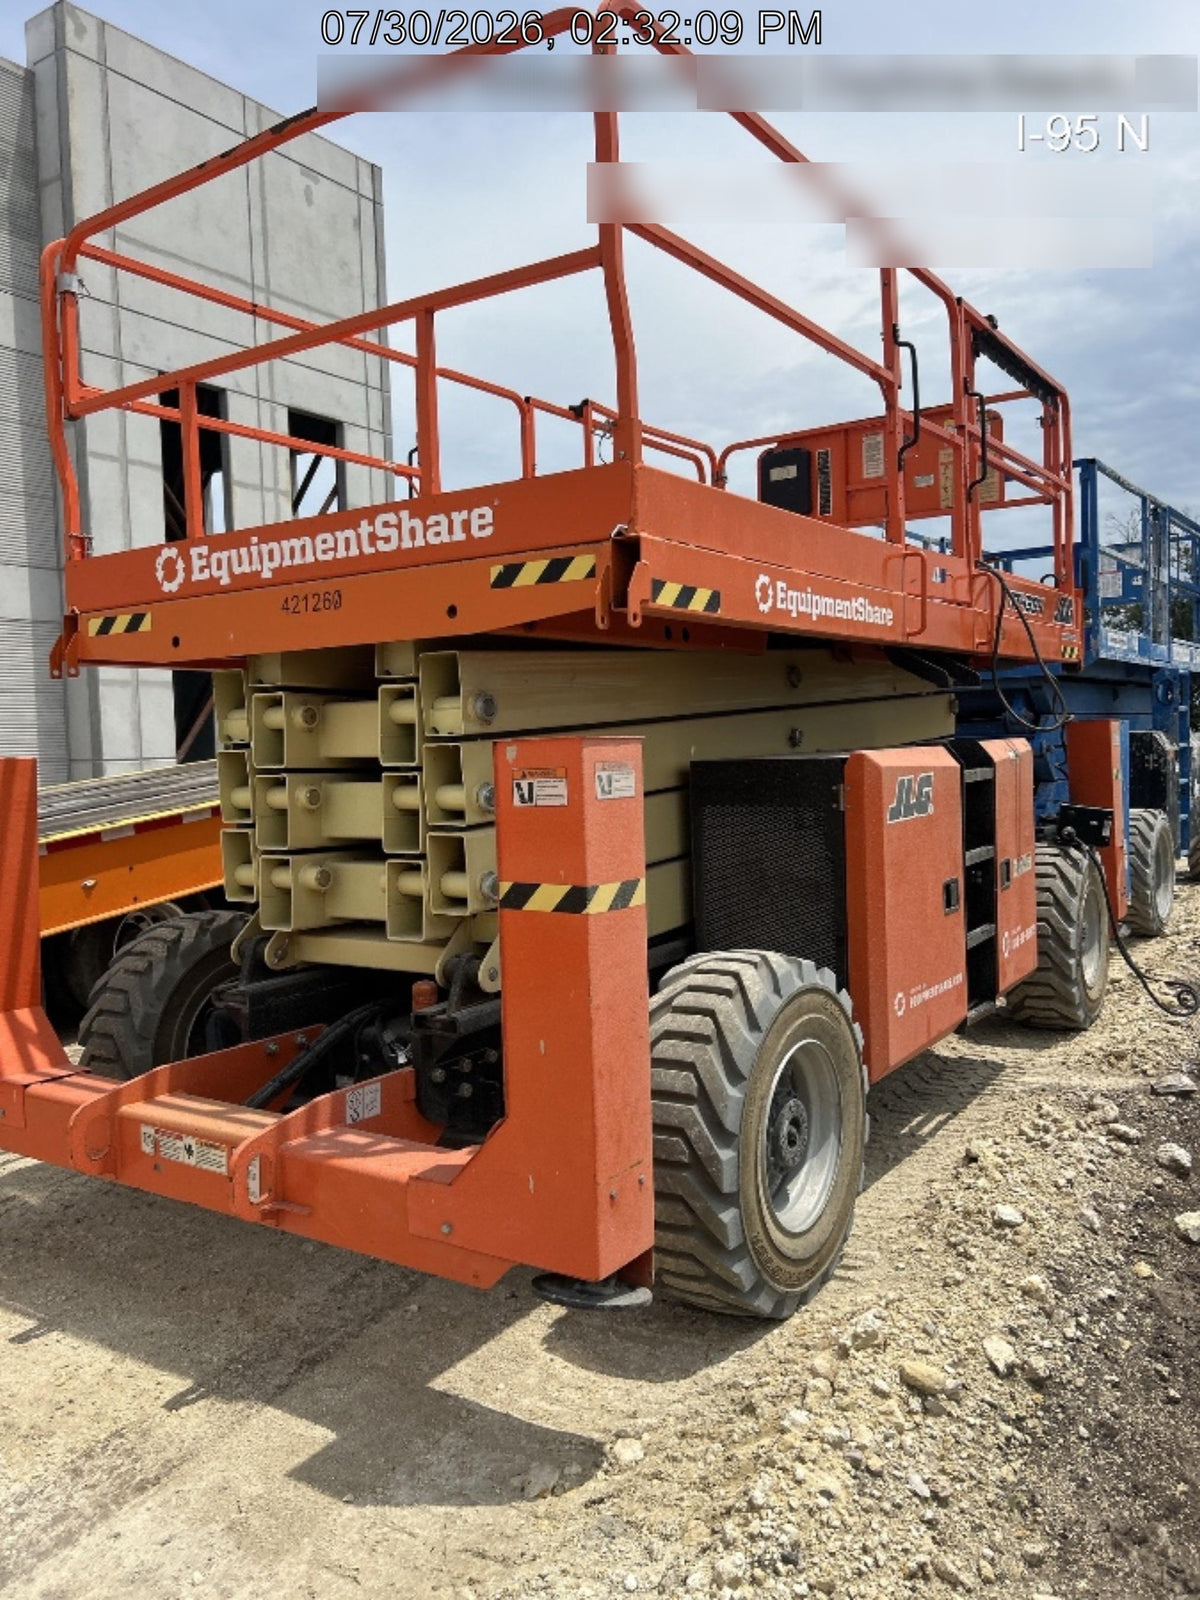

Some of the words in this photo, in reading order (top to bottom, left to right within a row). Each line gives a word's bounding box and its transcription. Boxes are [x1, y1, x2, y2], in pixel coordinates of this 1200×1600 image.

[190, 505, 494, 586] EquipmentShare
[281, 589, 342, 615] 421260
[776, 580, 894, 626] EquipmentShare
[887, 772, 934, 824] JLG
